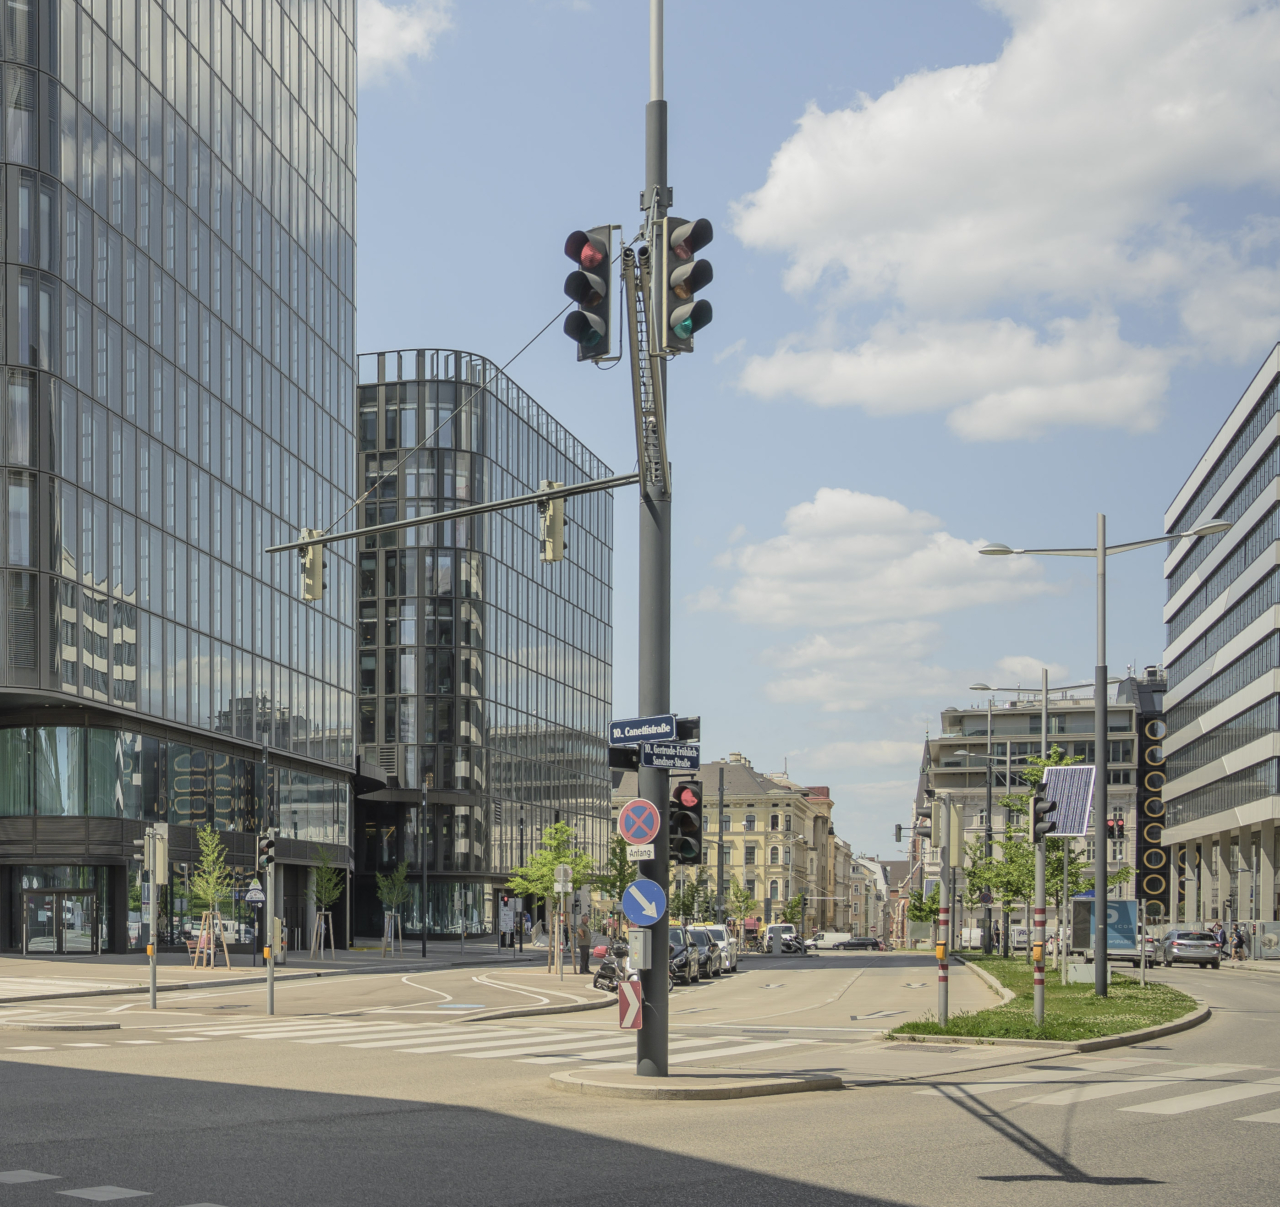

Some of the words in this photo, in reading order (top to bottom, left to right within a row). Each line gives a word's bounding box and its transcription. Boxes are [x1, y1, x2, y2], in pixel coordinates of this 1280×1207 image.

[625, 723, 671, 737] Canettistraße
[652, 755, 691, 768] Sandner-Straße
[628, 848, 652, 858] Anfang
